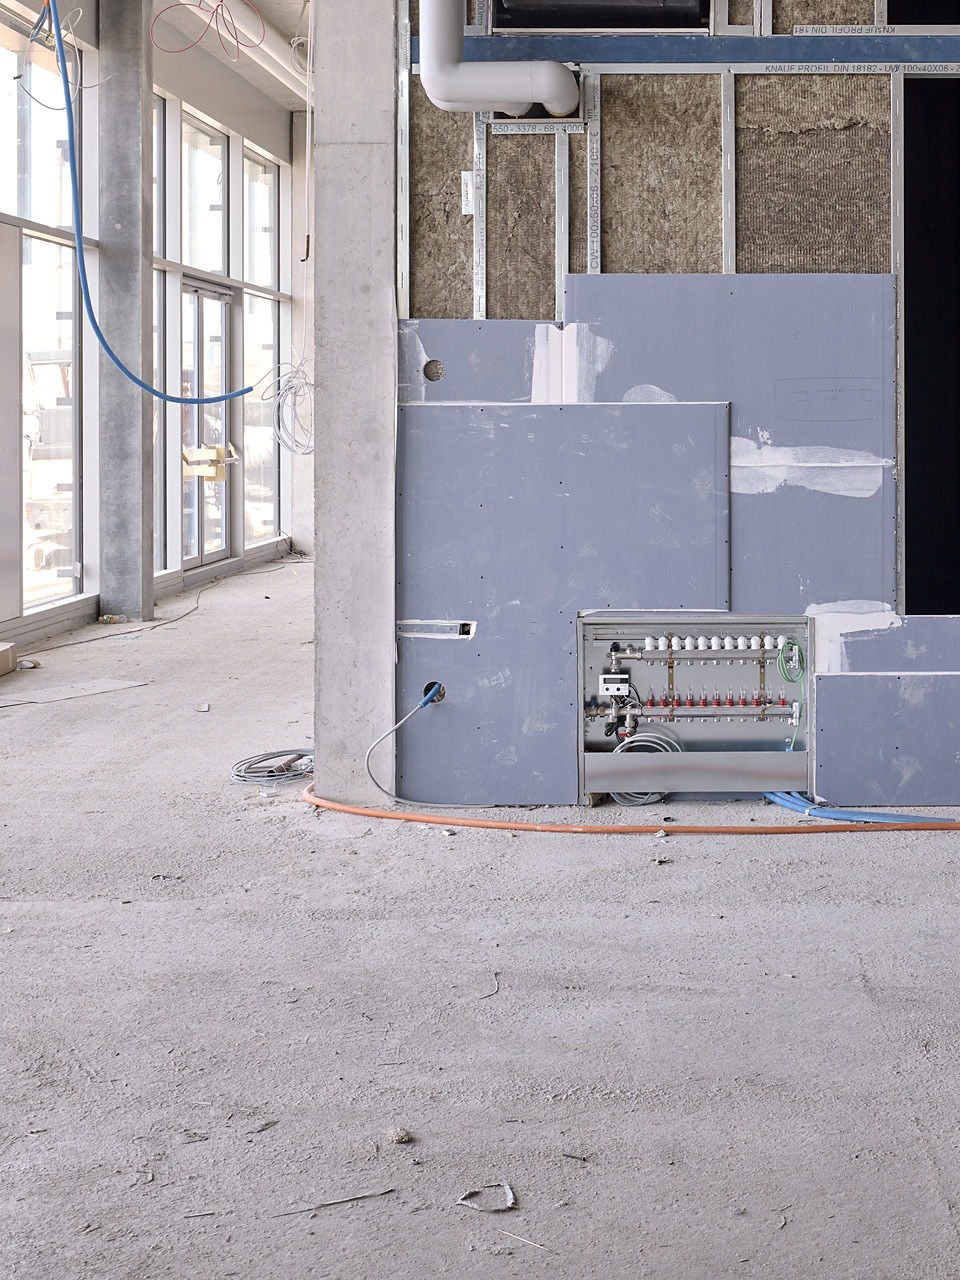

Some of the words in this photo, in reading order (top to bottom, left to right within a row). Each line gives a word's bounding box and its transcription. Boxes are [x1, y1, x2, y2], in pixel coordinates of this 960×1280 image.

[812, 26, 828, 34] DIN
[830, 26, 863, 34] PROFIL
[865, 26, 896, 34] KNAUF
[765, 64, 796, 73] KNAUF
[798, 64, 830, 73] PROFIL
[833, 64, 849, 73] DIN
[852, 64, 878, 73] 18182
[516, 124, 537, 133] 3378
[544, 124, 555, 133] 69
